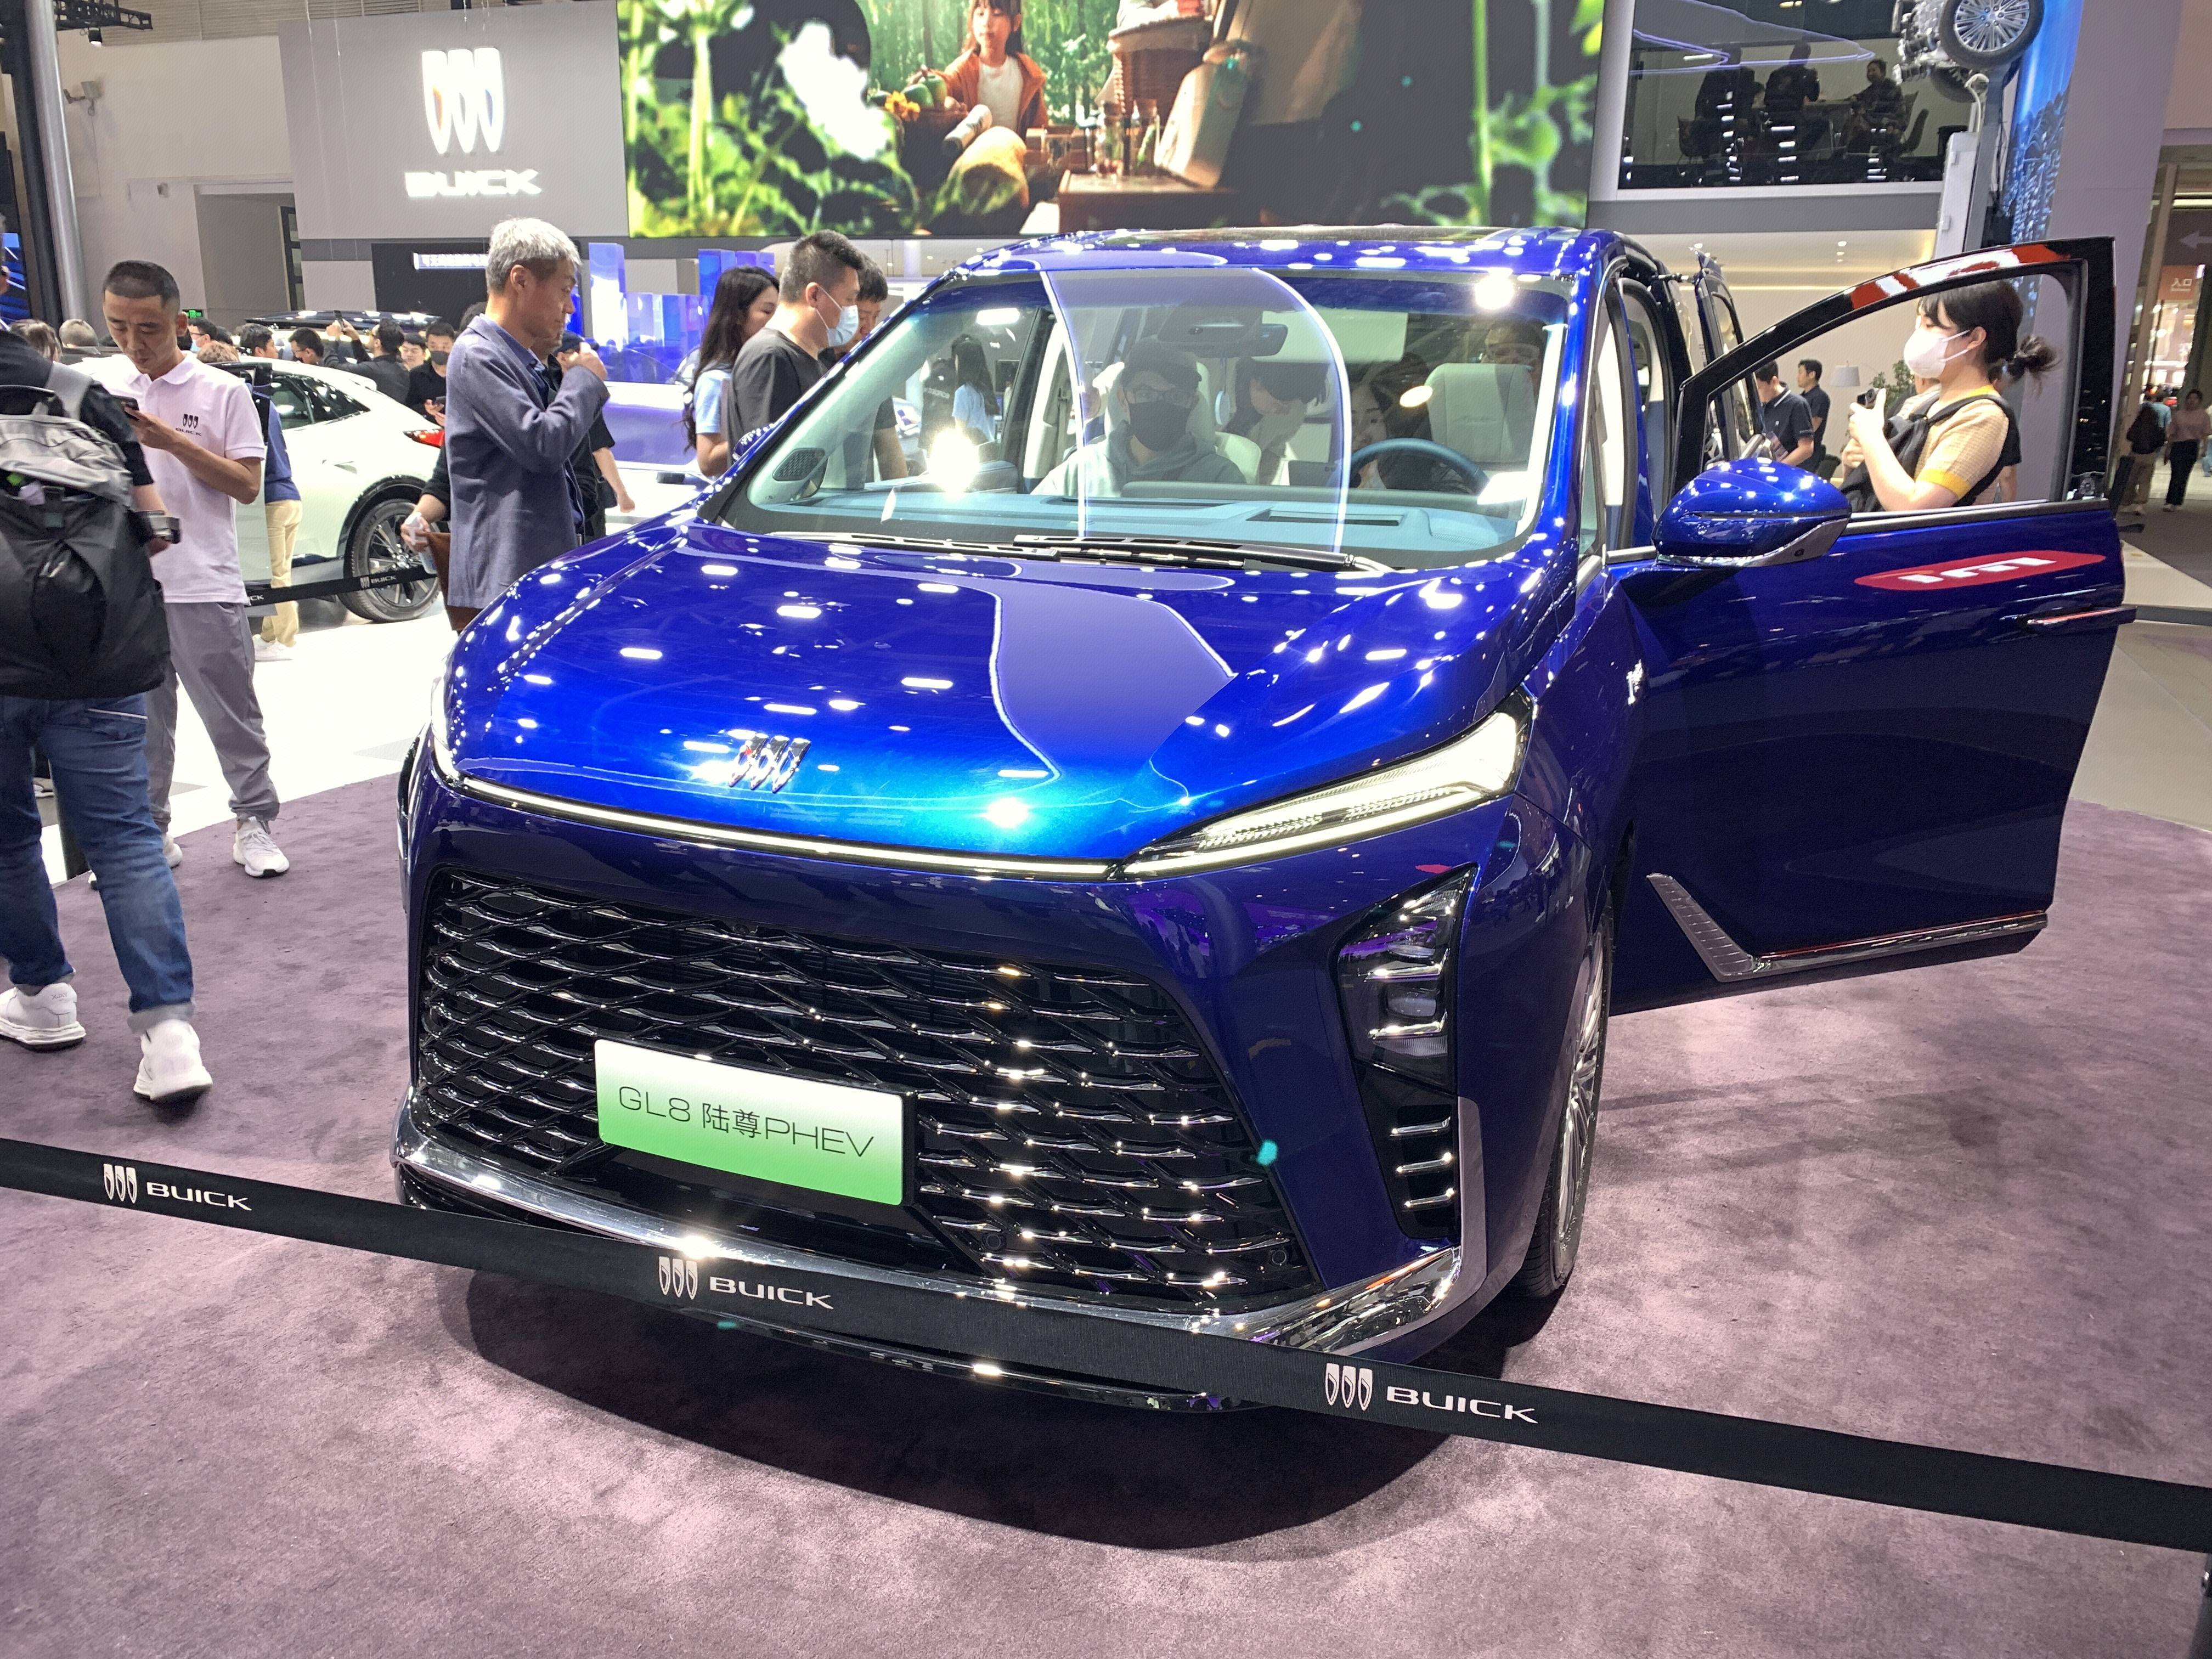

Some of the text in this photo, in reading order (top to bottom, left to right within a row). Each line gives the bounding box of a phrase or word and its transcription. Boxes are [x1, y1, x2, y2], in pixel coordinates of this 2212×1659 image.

[404, 169, 542, 197] BUICK
[176, 427, 202, 437] BUICK
[371, 575, 397, 583] BUICK
[619, 1085, 874, 1158] GL8 陆尊PHEV
[146, 1181, 252, 1211] BUICK
[709, 1276, 834, 1310] BUICK
[1386, 1386, 1538, 1424] BUICK
